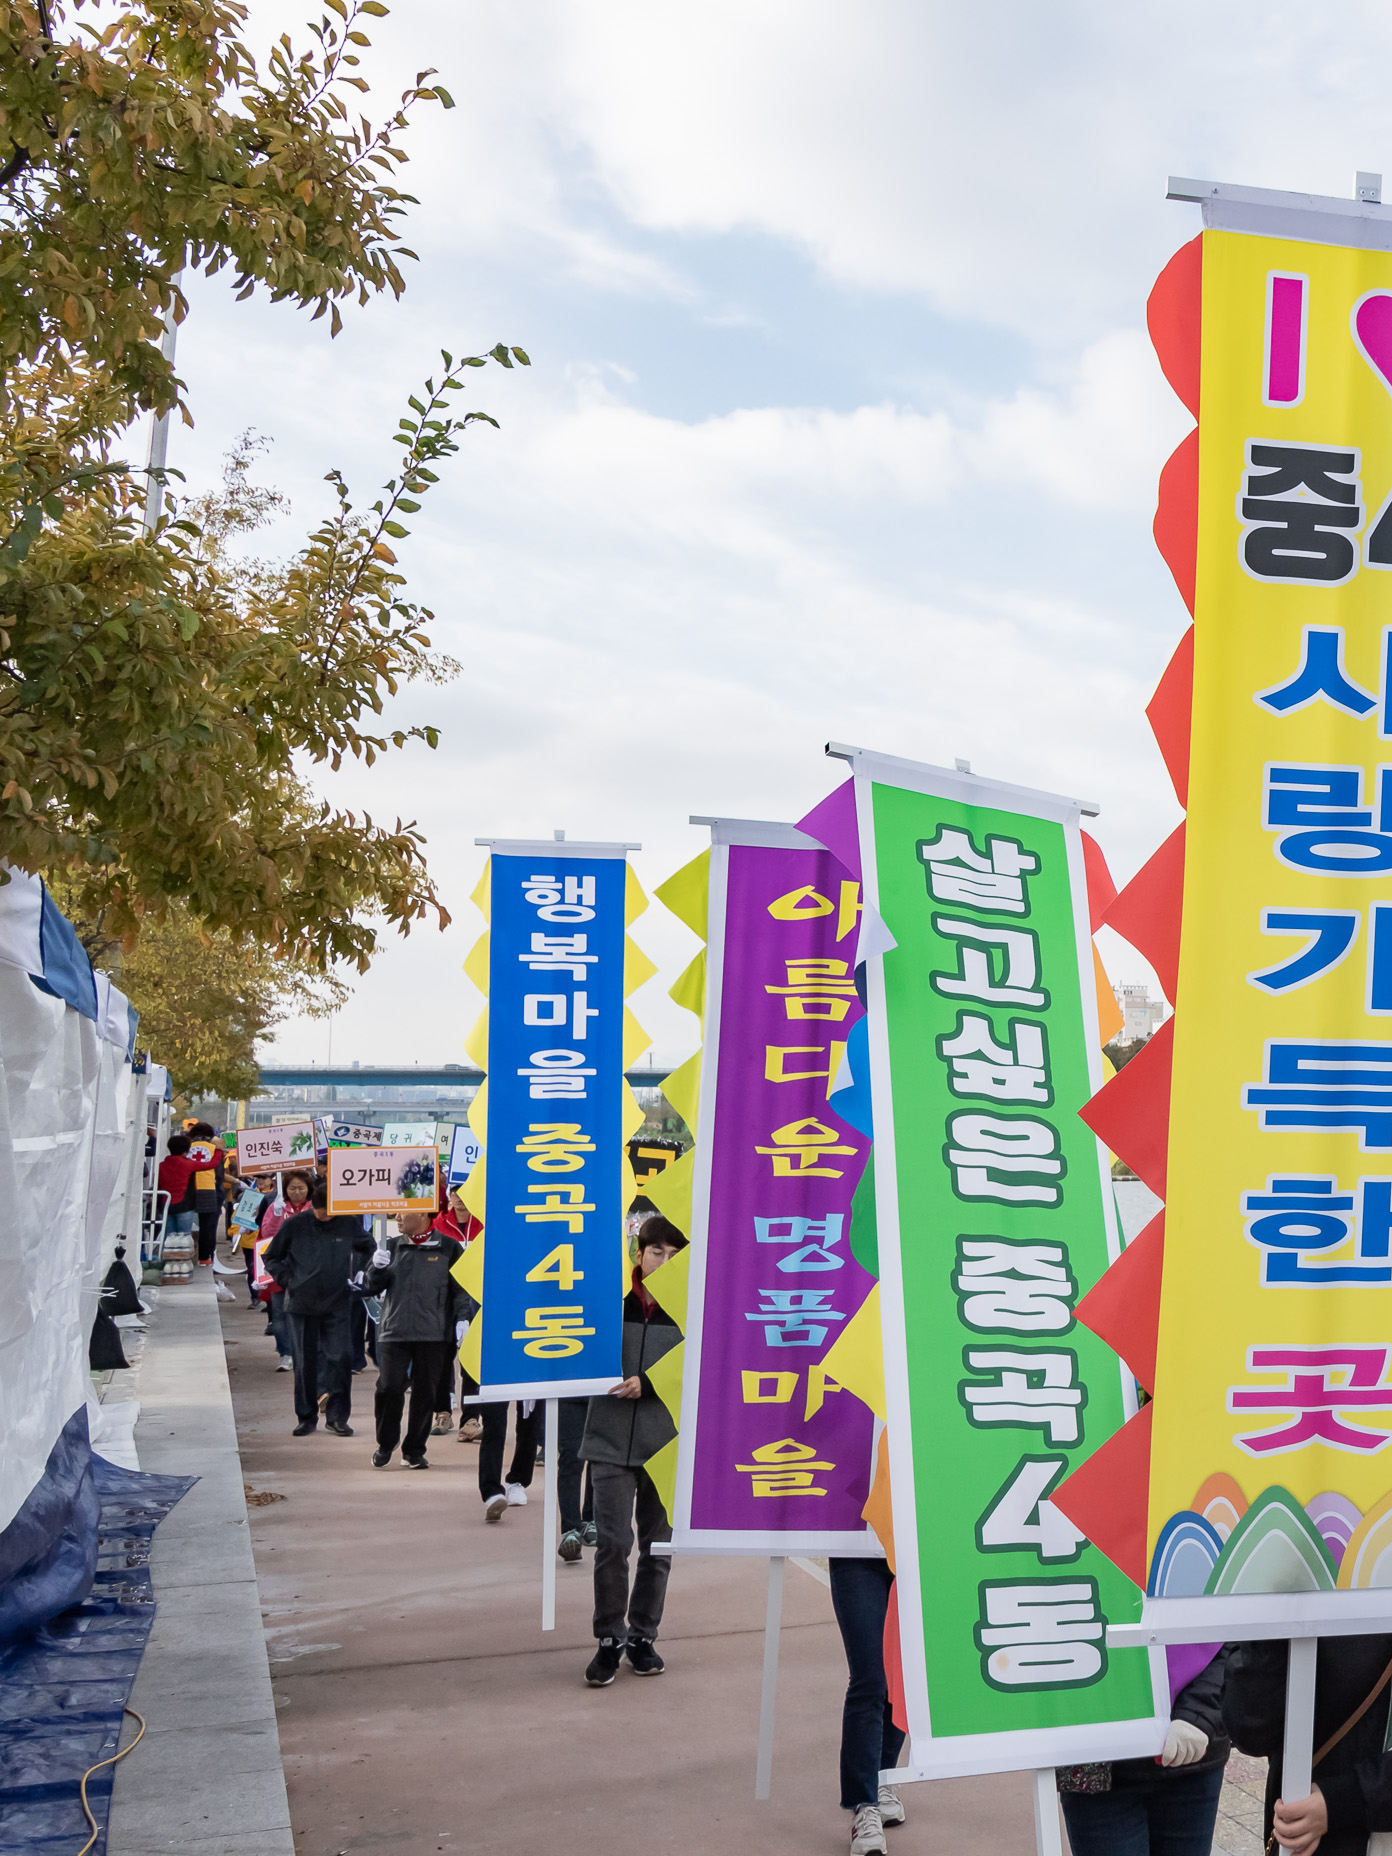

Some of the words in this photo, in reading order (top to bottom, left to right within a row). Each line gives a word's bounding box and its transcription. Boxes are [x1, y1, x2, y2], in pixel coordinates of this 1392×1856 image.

[1262, 270, 1309, 408] I
[517, 874, 600, 1100] 행복마을
[754, 880, 862, 1180] 아름다운
[916, 822, 1067, 1209] 살고싶은
[246, 1140, 283, 1158] 인진쑥
[340, 1168, 391, 1186] 오가피
[512, 1123, 596, 1359] 중곡4동
[949, 1233, 1107, 1692] 중곡4동
